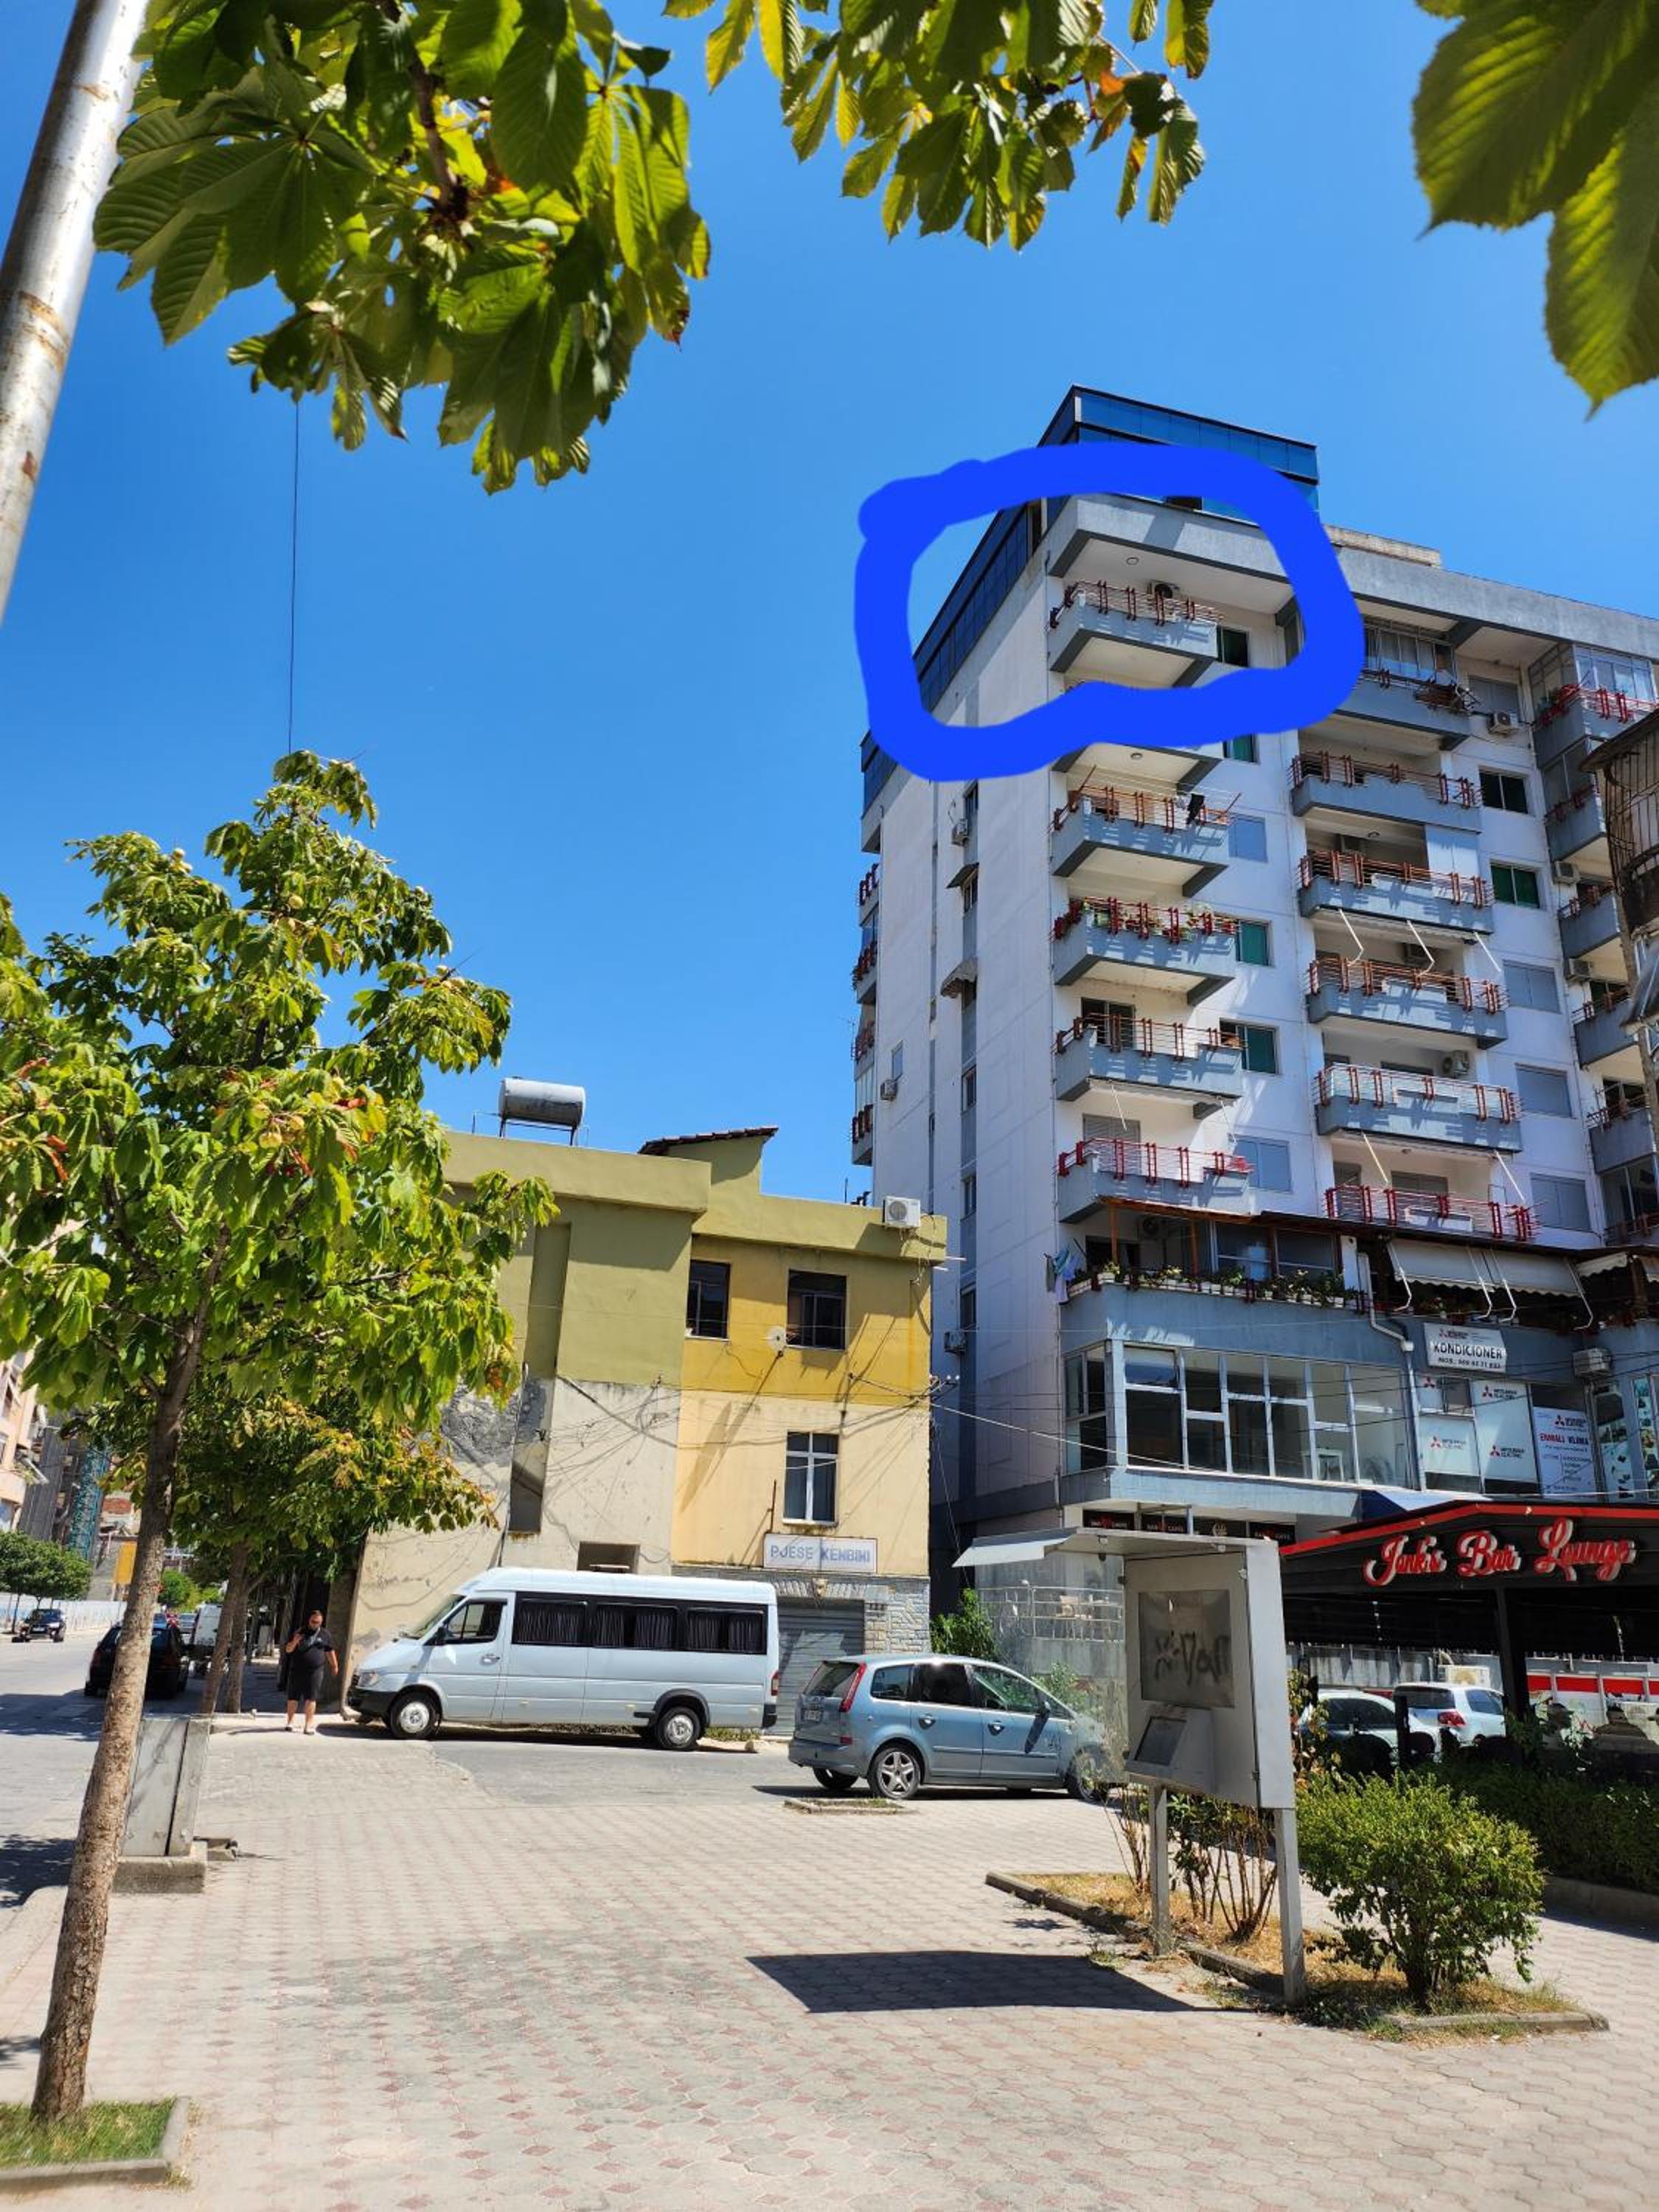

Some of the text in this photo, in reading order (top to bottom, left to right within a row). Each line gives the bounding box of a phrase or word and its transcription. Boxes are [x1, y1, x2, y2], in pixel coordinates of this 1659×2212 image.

[1433, 1342, 1503, 1360] KONDICIONER
[771, 1545, 814, 1560] PJESE
[1456, 1529, 1522, 1577] Bar
[1534, 1517, 1638, 1582] Lounge
